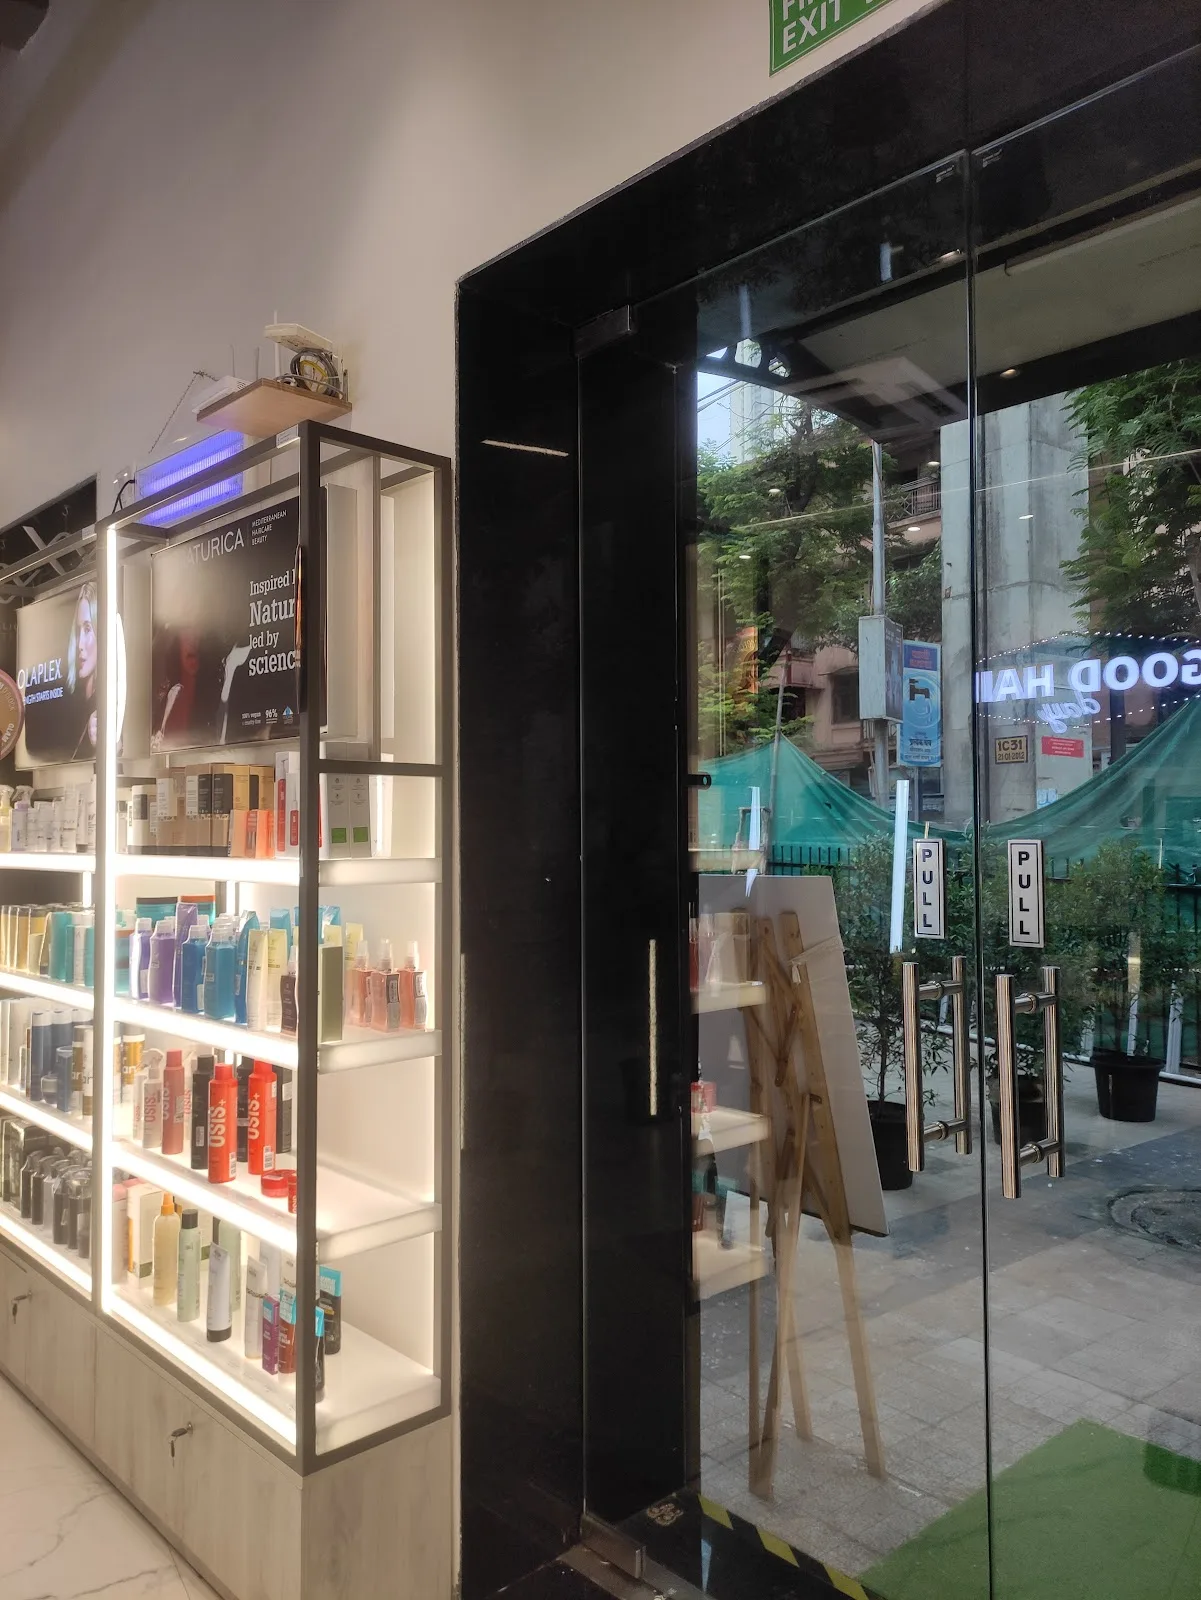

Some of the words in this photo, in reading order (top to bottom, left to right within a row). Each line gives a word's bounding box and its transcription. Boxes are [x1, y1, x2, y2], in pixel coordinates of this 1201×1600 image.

[783, 0, 841, 55] EXIT
[251, 509, 287, 527] MEDITERRANEAN
[251, 524, 272, 536] HAIRCARE
[186, 528, 244, 565] ATURICA
[251, 535, 267, 545] BEAUTY
[250, 570, 289, 596] Inspired
[249, 597, 296, 627] Natur
[249, 631, 264, 650] led
[266, 630, 279, 648] by
[17, 657, 63, 690] OLAPLEX
[248, 648, 297, 676] scienc
[265, 708, 278, 718] 96%
[997, 739, 1023, 752] 1C31
[922, 848, 934, 928] PULL
[1018, 851, 1031, 935] PULL
